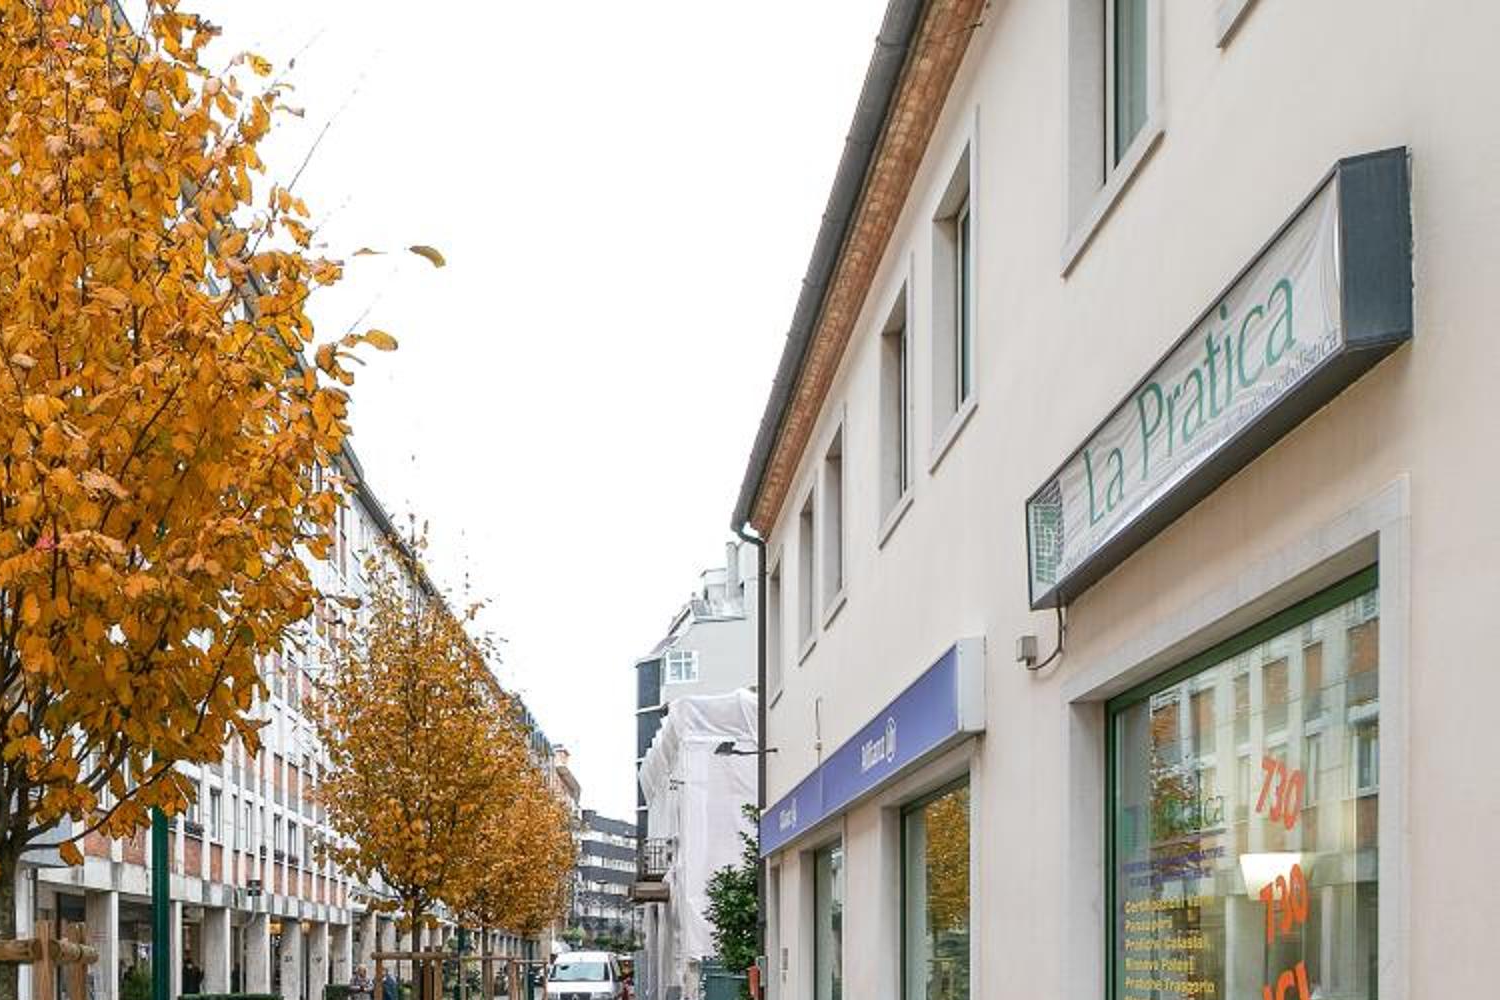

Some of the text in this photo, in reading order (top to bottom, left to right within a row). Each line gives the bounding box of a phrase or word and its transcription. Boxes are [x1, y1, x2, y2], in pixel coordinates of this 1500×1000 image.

[1082, 447, 1125, 529] La
[1136, 277, 1297, 481] Pratica
[1255, 754, 1306, 831] 730
[1259, 863, 1310, 945] 730
